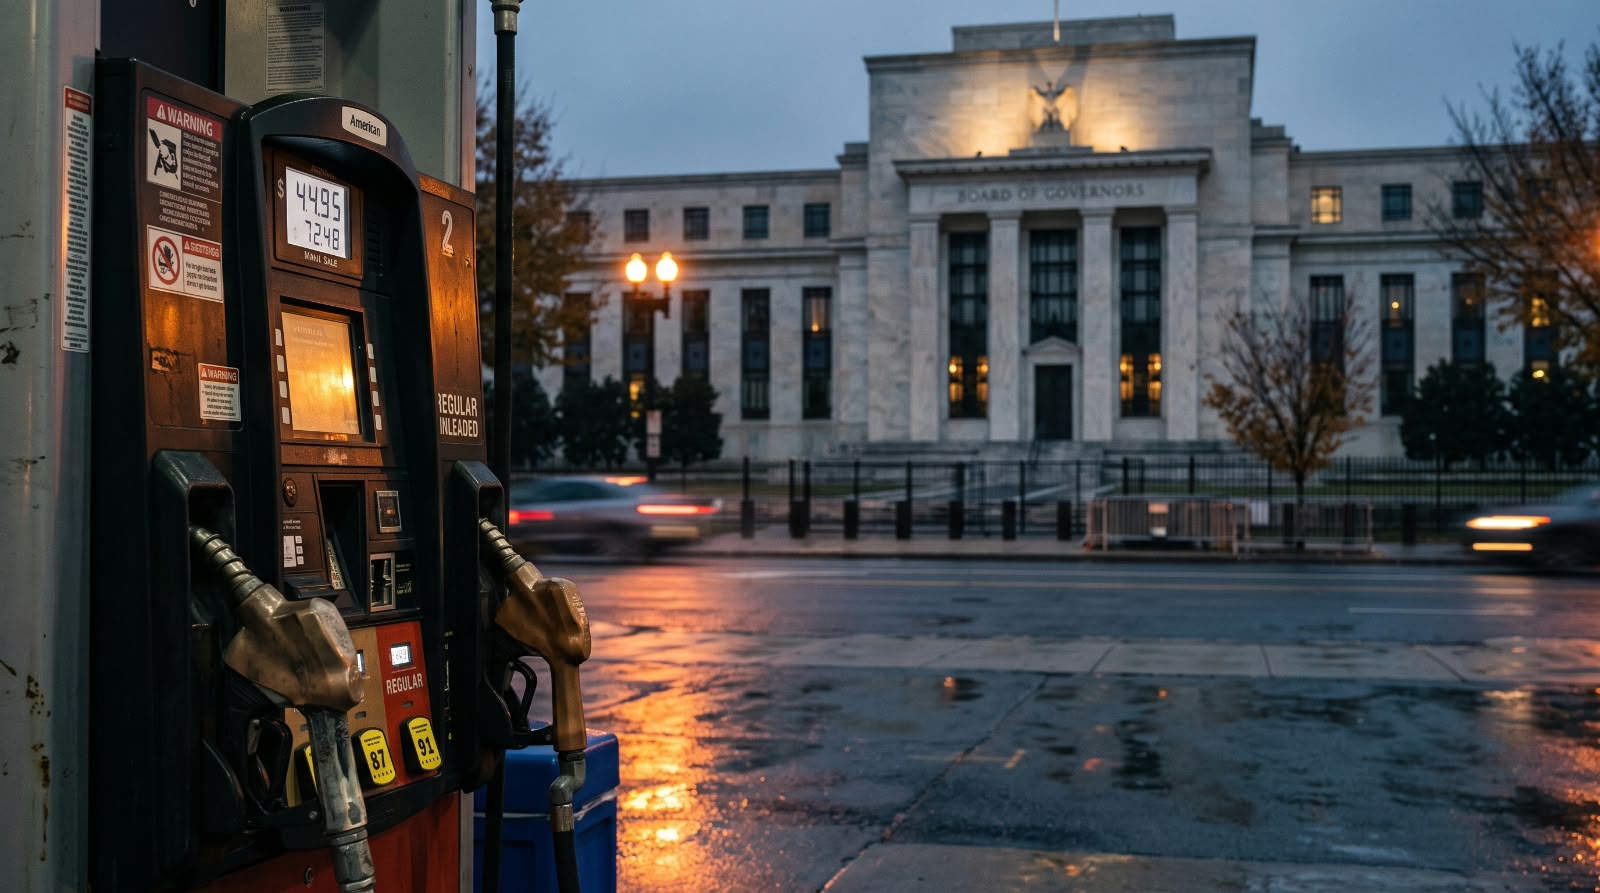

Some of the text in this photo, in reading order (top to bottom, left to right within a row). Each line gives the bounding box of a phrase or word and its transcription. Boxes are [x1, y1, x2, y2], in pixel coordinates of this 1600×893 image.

[167, 106, 213, 137] WARNING
[350, 114, 380, 136] American
[278, 178, 284, 198] $
[958, 183, 1144, 203] BOARD OF GOVERNORS
[442, 210, 454, 258] 2
[207, 368, 237, 381] WARNING
[386, 672, 424, 694] REGULAR
[418, 736, 434, 756] 91
[370, 748, 386, 770] 87
